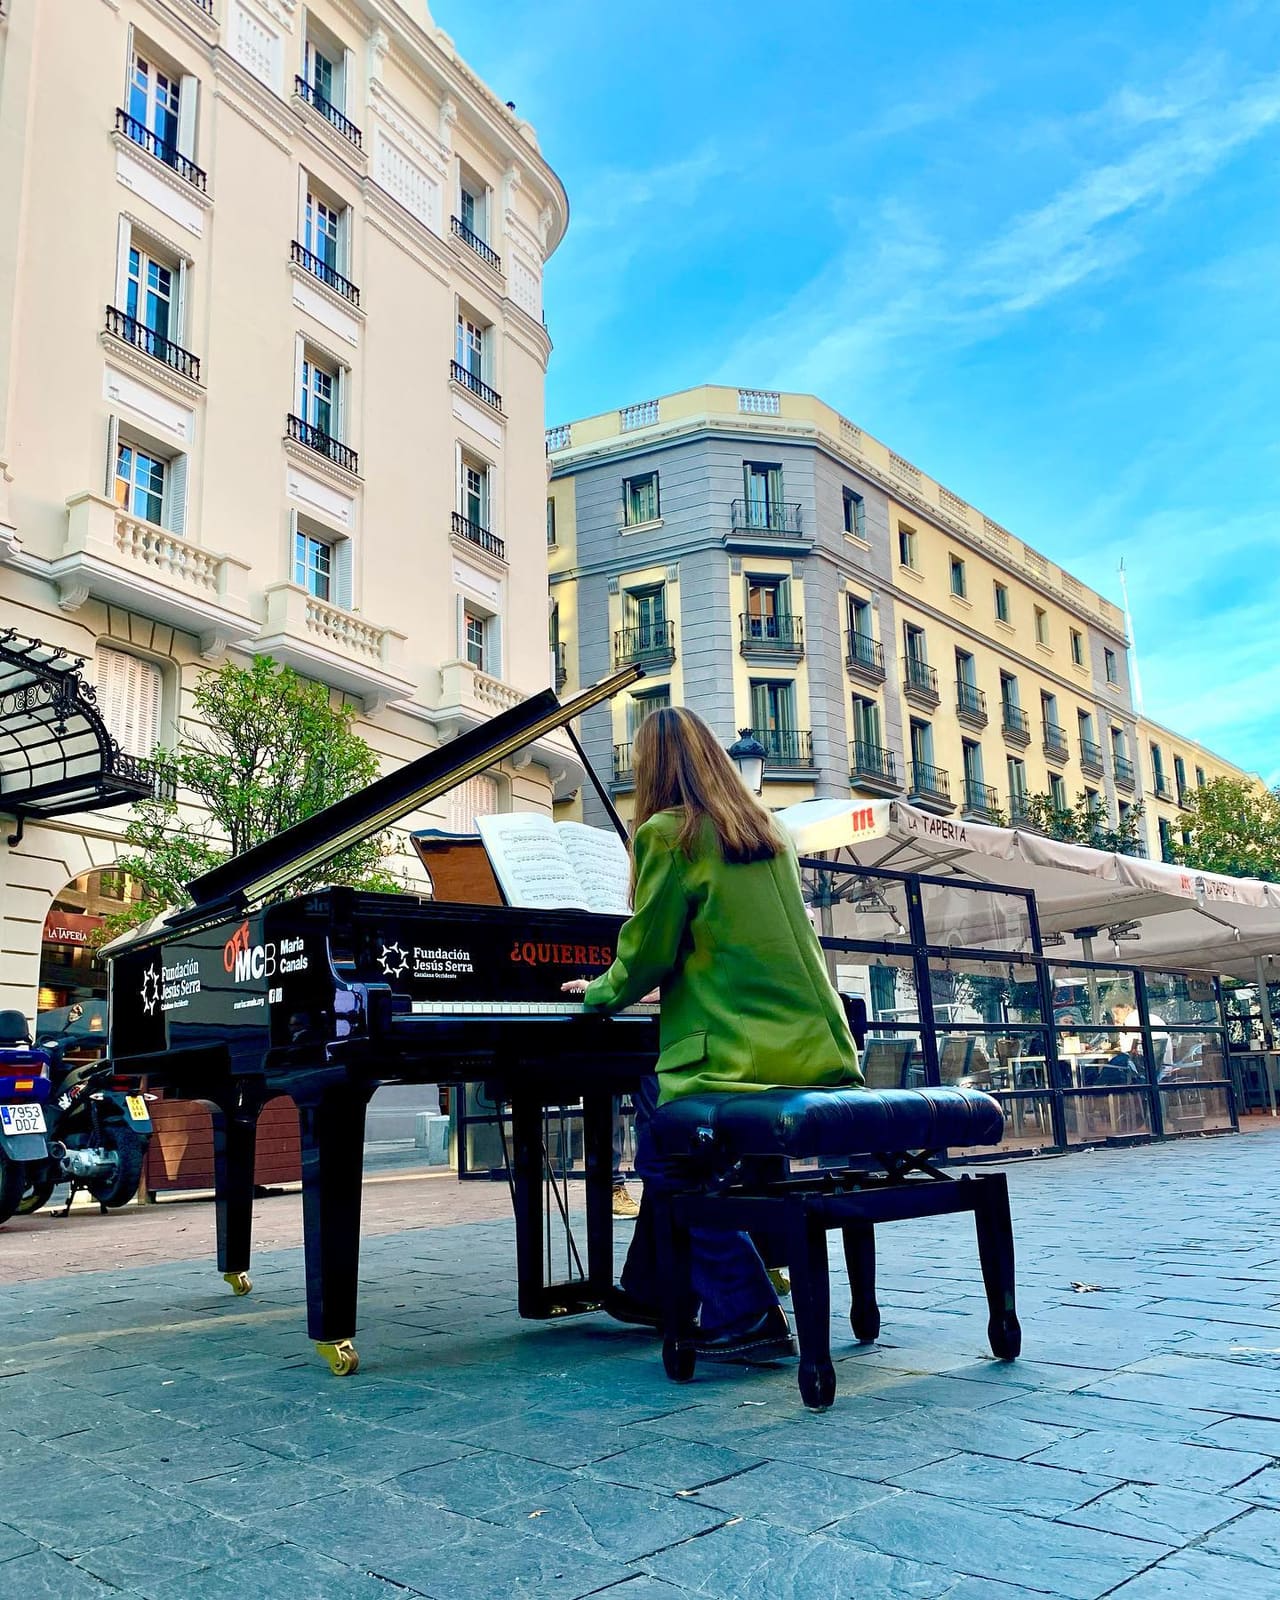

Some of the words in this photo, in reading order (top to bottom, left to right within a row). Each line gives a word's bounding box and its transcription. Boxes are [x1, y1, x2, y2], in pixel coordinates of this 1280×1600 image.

[908, 817, 917, 829] LA
[48, 928, 57, 938] LA
[280, 936, 304, 955] Maria
[413, 947, 470, 961] Fundación
[510, 942, 612, 966] ¿QUIERES
[161, 957, 199, 982] Fundación
[235, 943, 276, 983] MCB
[279, 954, 309, 974] Canals
[412, 959, 443, 972] Jesús
[445, 961, 474, 972] Serra
[160, 981, 181, 1000] Jesús
[180, 979, 201, 996] Serra
[9, 1106, 41, 1119] 7953
[15, 1118, 39, 1131] DDZ
